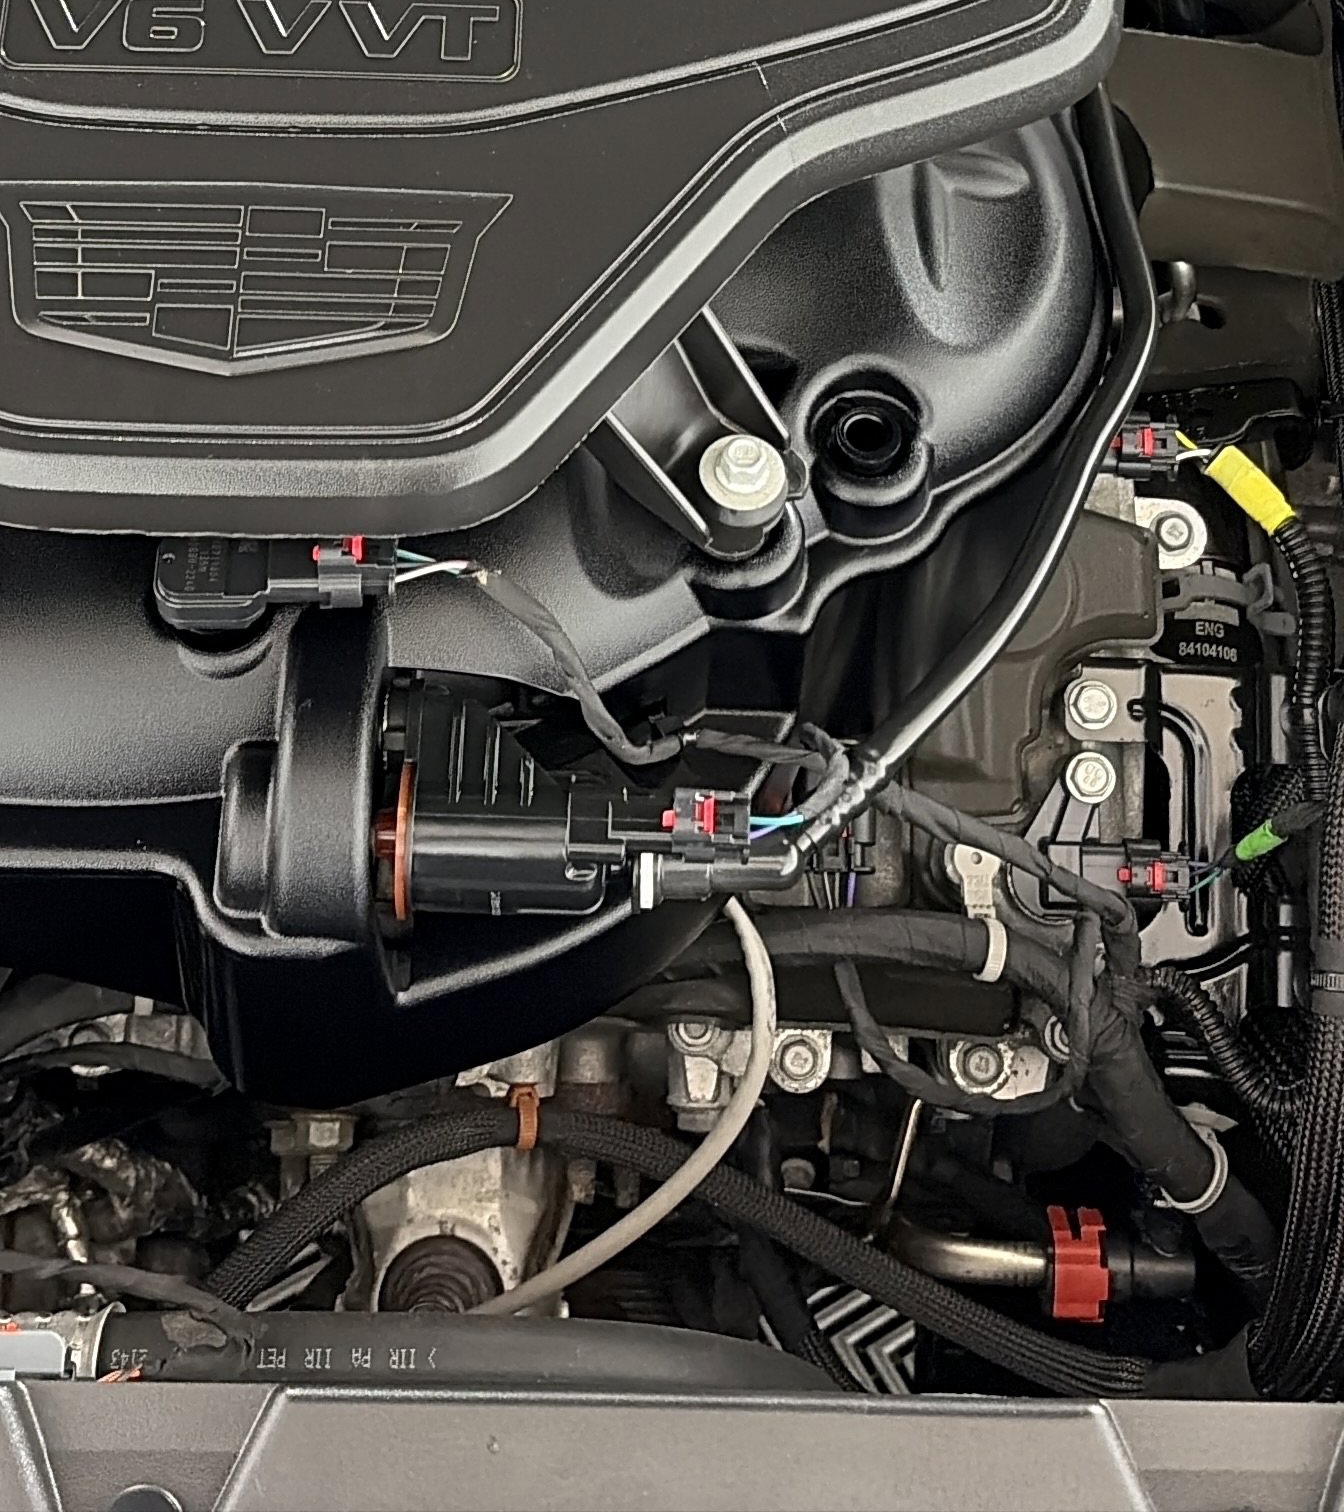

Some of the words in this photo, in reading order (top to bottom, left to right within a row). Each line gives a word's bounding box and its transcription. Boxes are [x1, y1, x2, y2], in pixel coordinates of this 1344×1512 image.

[1195, 620, 1225, 638] ENG
[256, 1348, 287, 1368] PET
[351, 1348, 372, 1368] PA
